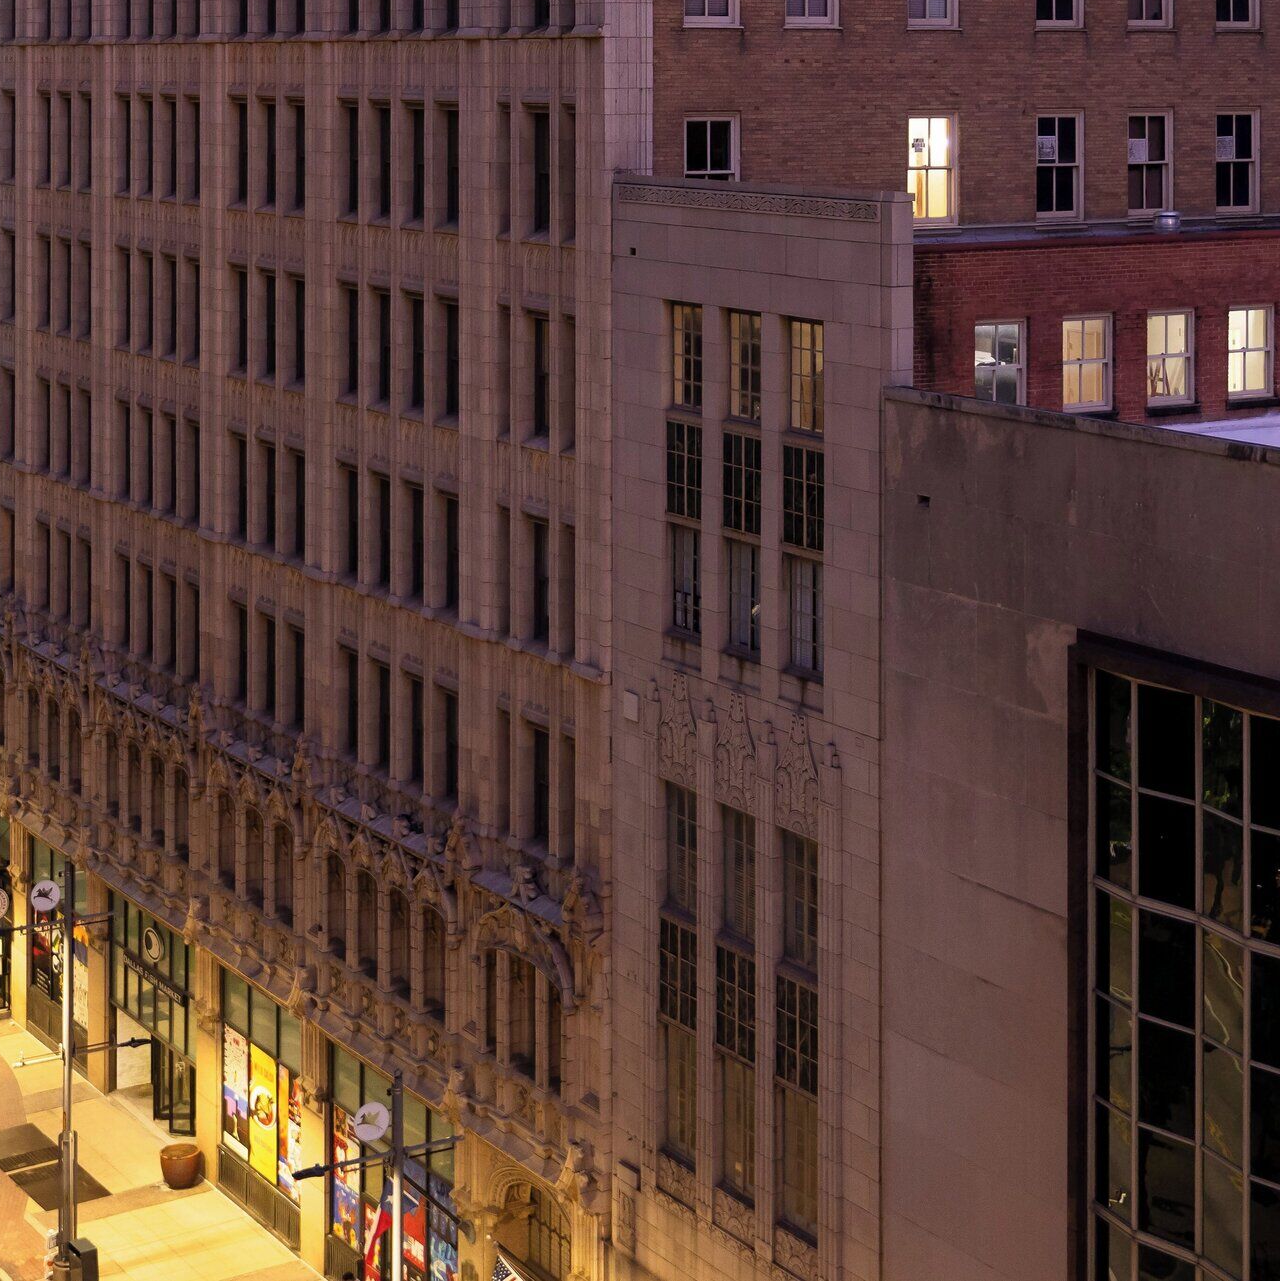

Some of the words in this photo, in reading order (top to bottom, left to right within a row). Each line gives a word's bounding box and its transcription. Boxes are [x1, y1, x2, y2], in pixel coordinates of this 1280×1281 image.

[123, 954, 144, 976] DALLAS
[144, 970, 158, 987] FISH
[159, 981, 181, 1004] MARKET
